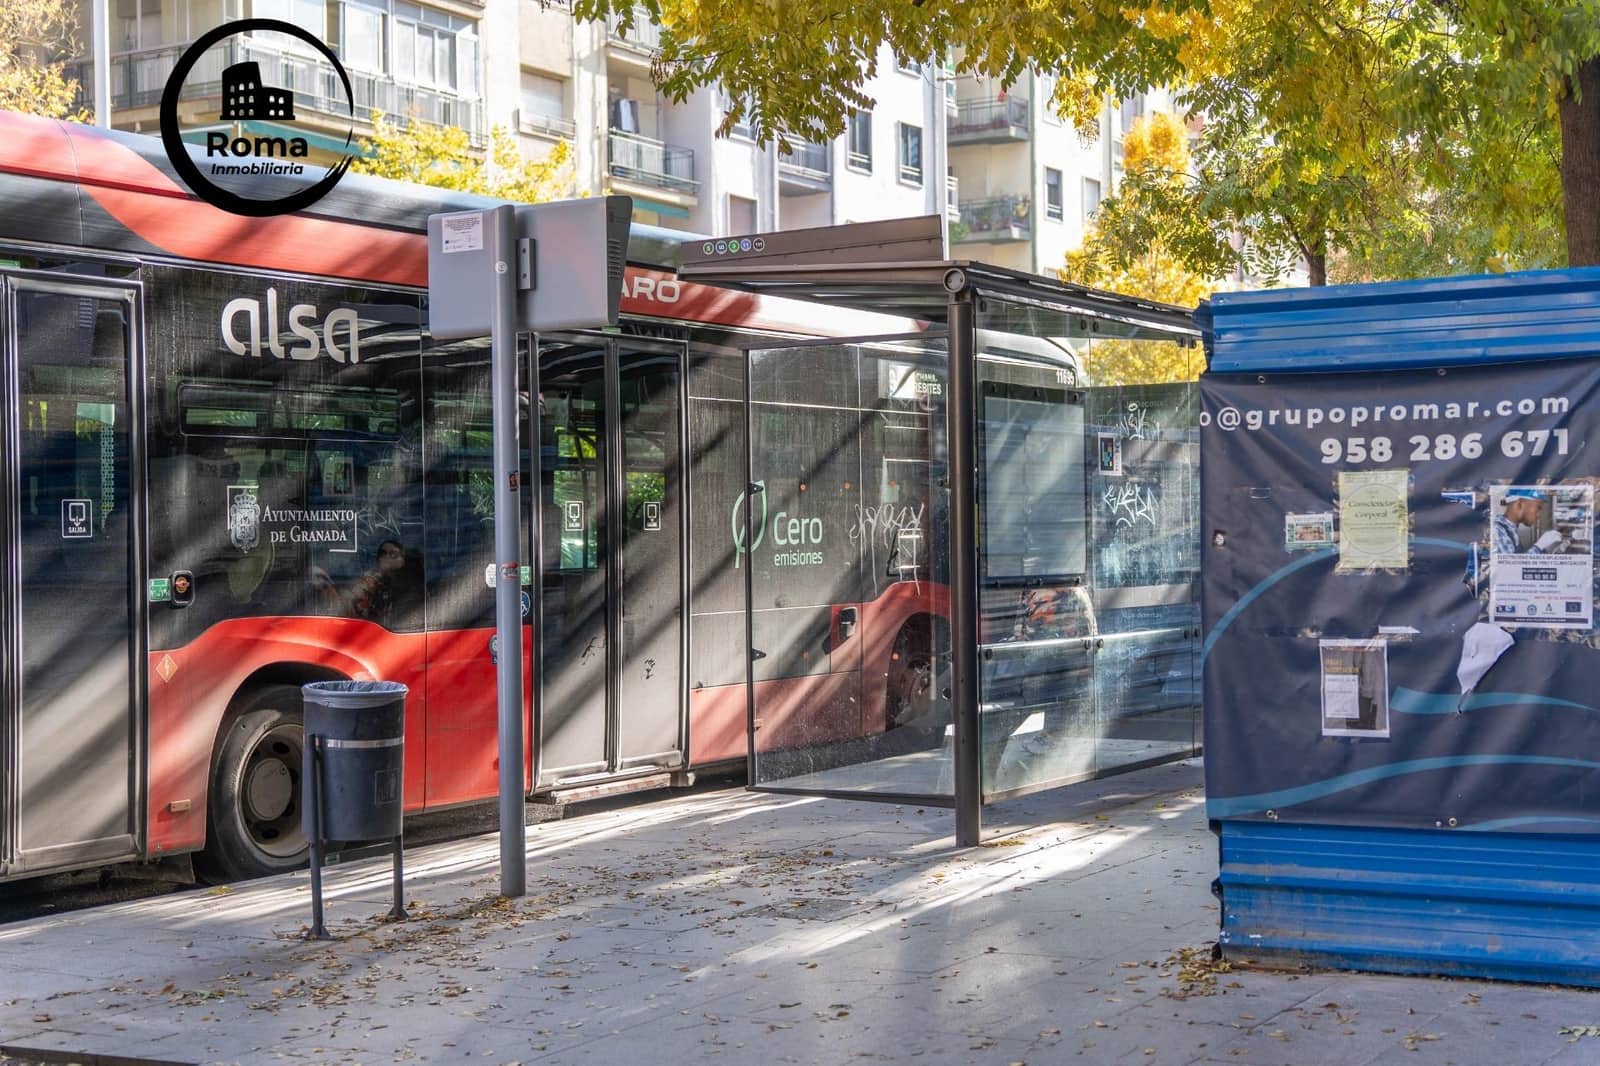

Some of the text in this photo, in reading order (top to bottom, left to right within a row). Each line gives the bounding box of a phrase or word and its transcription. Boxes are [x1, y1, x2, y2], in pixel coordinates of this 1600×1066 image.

[221, 287, 360, 364] alsa
[1320, 428, 1569, 464] 958 286 671
[262, 505, 354, 521] AYUNTAMIENTO
[290, 525, 347, 543] GRANADA
[774, 511, 823, 545] Cero
[774, 549, 823, 566] emisiones
